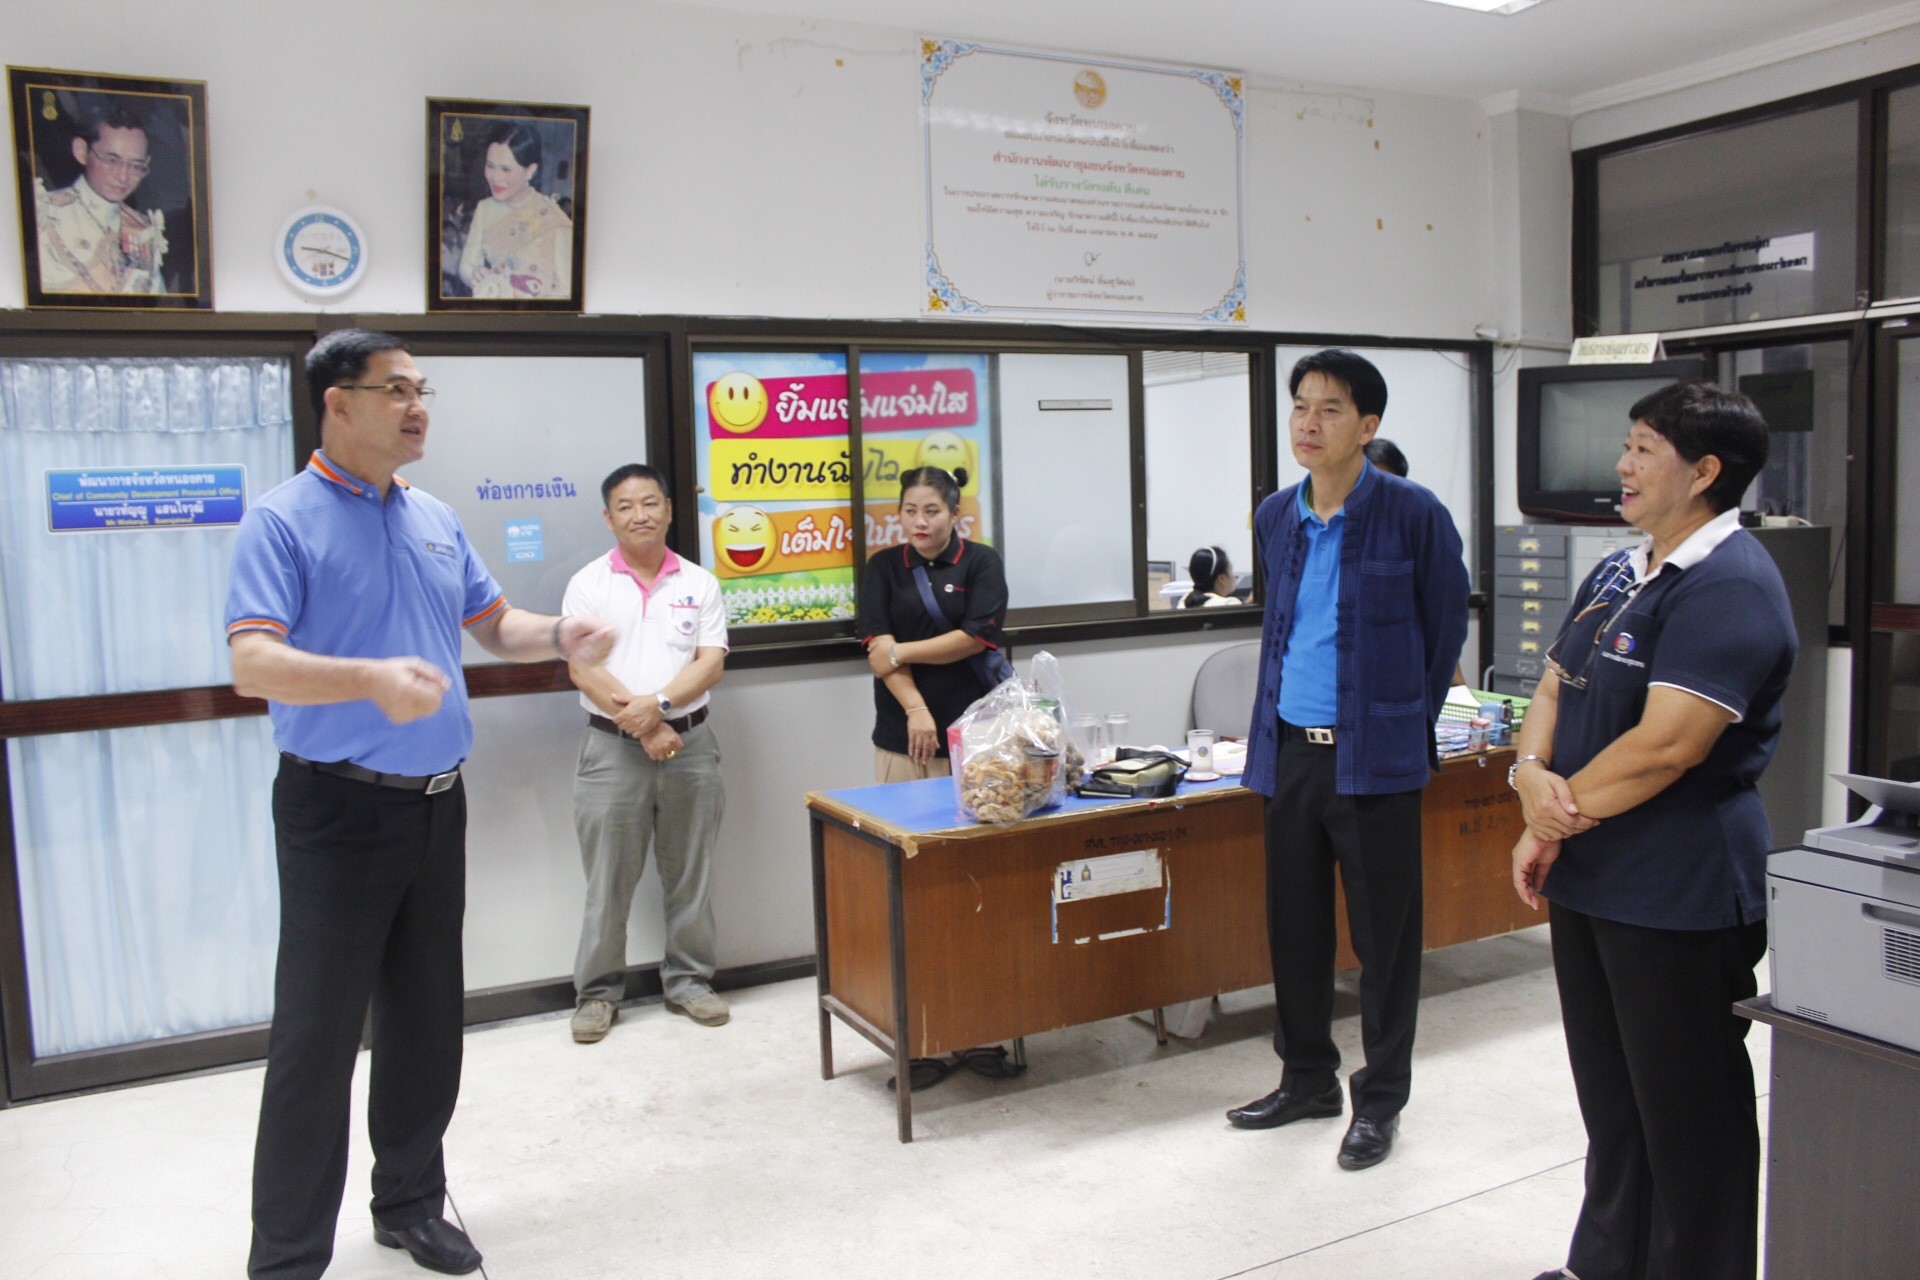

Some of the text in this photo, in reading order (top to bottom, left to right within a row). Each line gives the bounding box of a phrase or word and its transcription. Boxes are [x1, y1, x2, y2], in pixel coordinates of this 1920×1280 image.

[79, 471, 216, 488] พัฒนาการจังหวัดหนองคาย
[476, 476, 577, 500] ห้องการเงิน
[52, 486, 241, 500] Chief of Community Development Provincial Office
